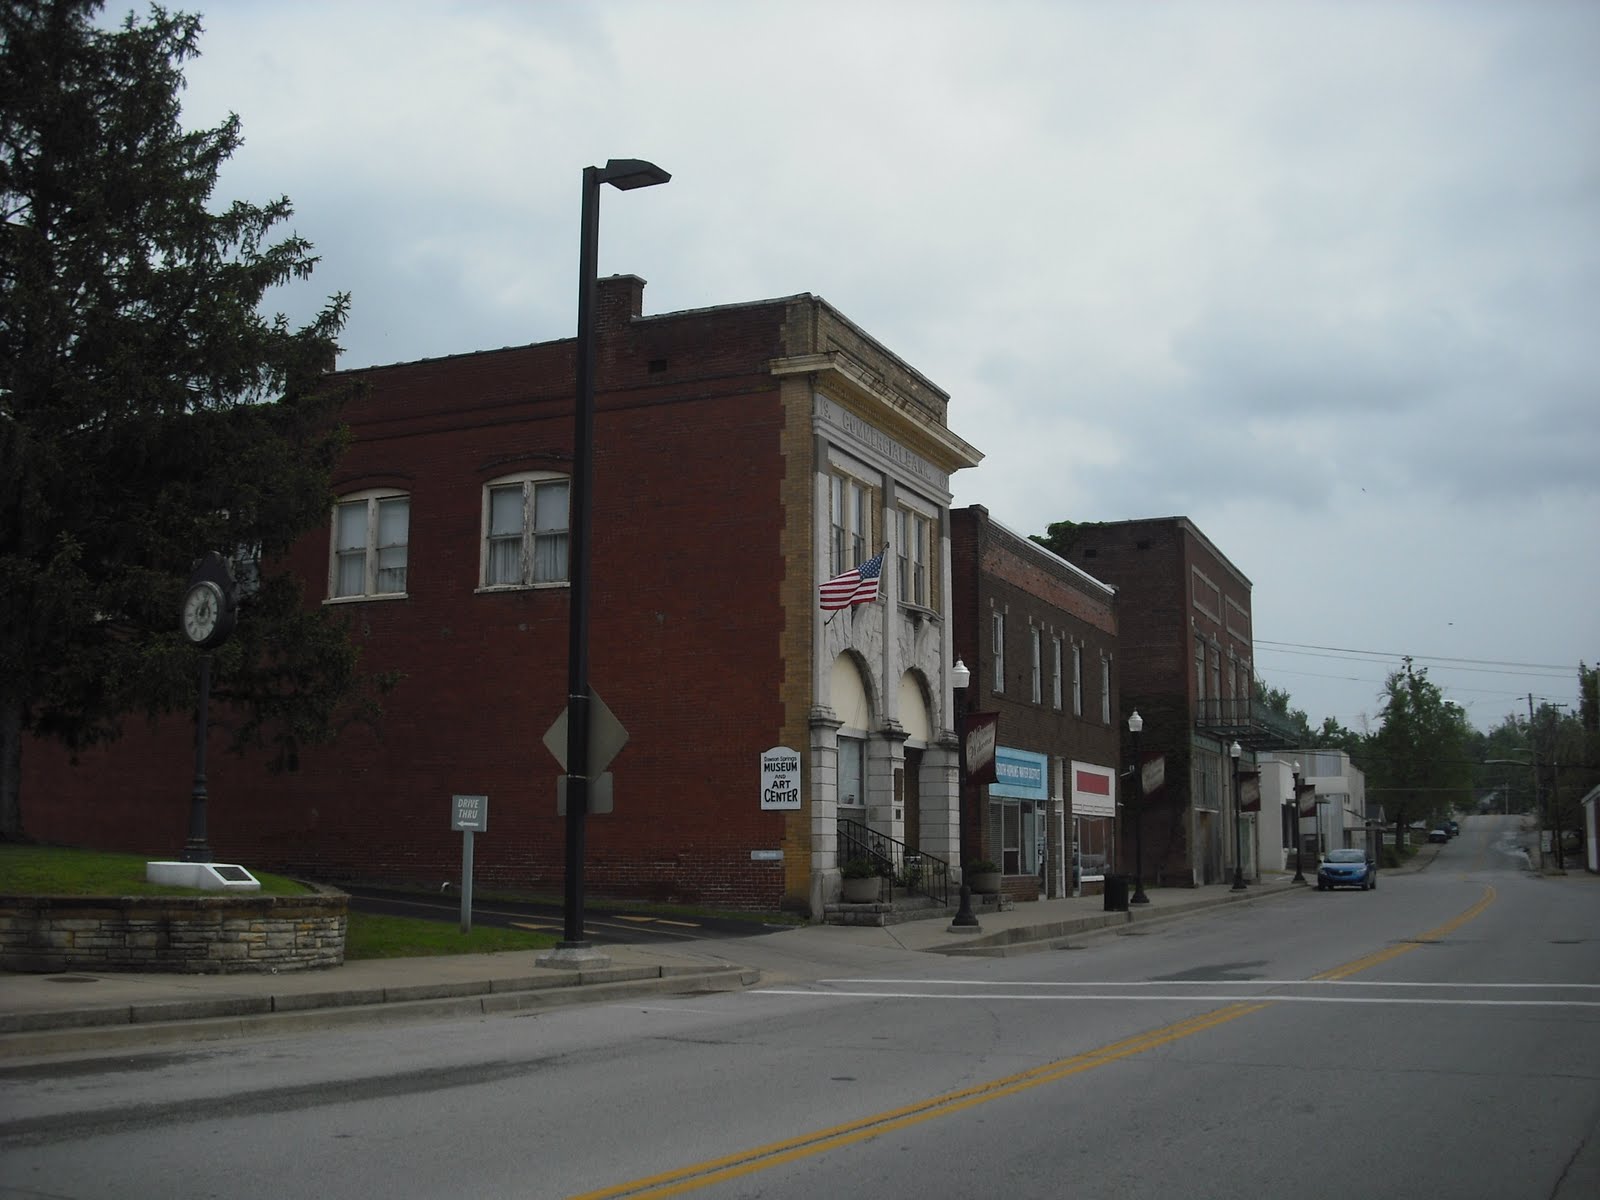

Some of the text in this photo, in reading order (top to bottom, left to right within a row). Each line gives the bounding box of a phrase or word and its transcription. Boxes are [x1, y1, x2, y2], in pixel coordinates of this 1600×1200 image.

[842, 411, 904, 464] COMMERCIAL
[780, 755, 797, 763] Springs
[764, 762, 797, 772] MUSEUM
[772, 780, 791, 789] ART
[764, 788, 798, 803] CENTER
[458, 798, 479, 809] DRIVE
[459, 809, 478, 819] THRU
